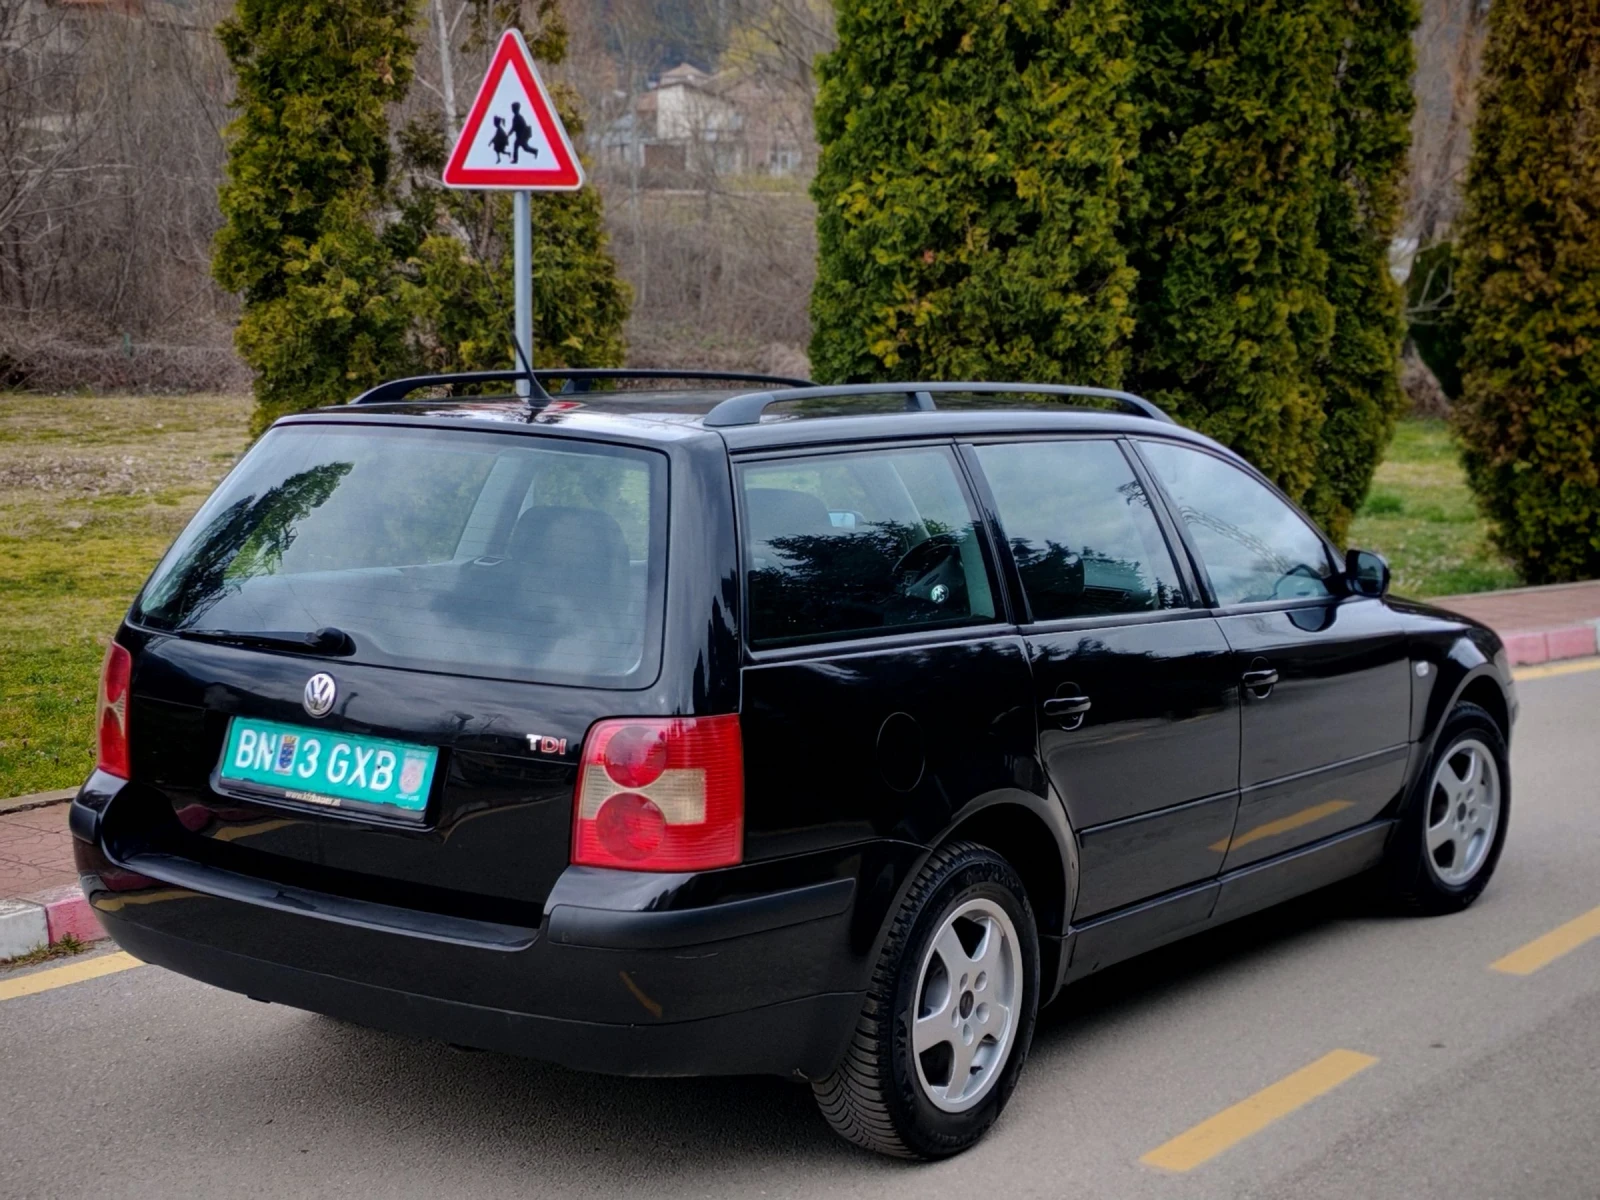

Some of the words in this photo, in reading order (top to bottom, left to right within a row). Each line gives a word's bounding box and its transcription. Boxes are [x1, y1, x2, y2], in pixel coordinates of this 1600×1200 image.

[235, 729, 277, 771] BN
[298, 738, 321, 778] 3
[326, 743, 397, 791] GXB
[526, 733, 567, 755] TDI
